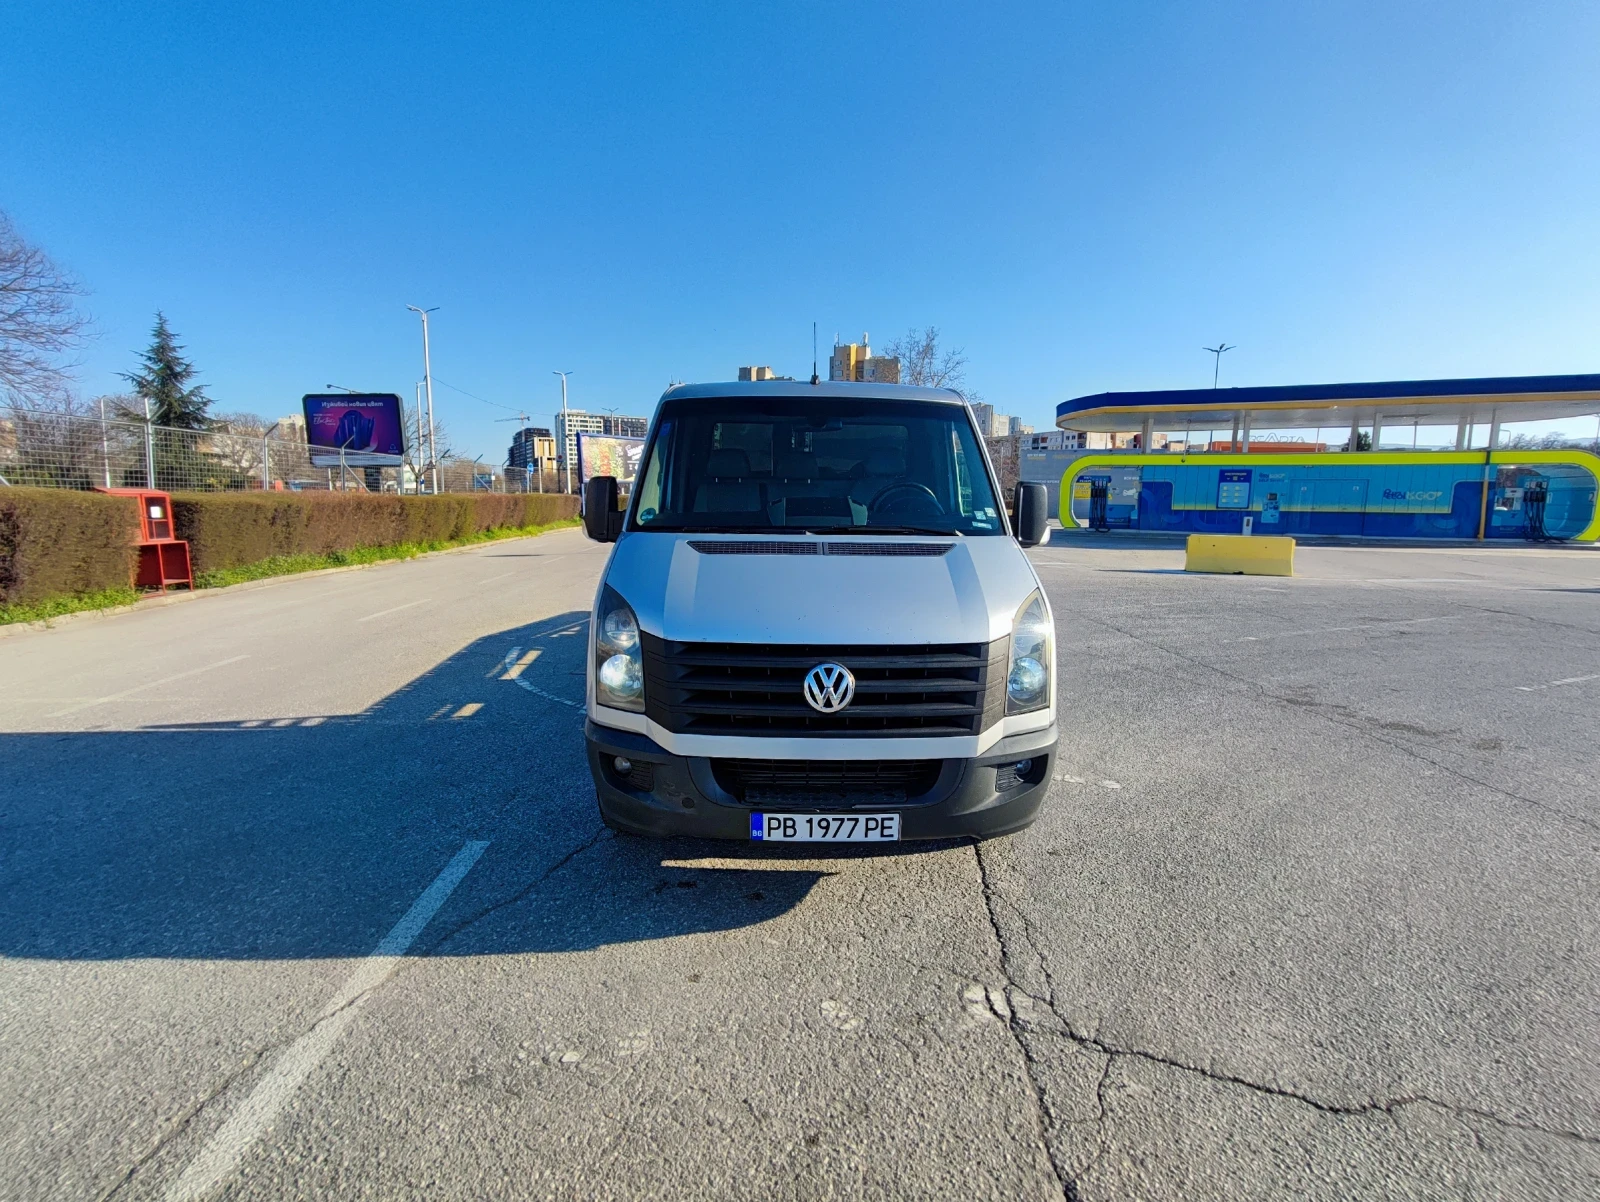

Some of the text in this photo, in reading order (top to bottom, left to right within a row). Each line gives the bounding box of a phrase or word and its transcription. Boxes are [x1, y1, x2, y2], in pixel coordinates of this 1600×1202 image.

[804, 662, 855, 713] VW
[752, 829, 763, 837] BG
[767, 817, 894, 838] PB 1977 PE
